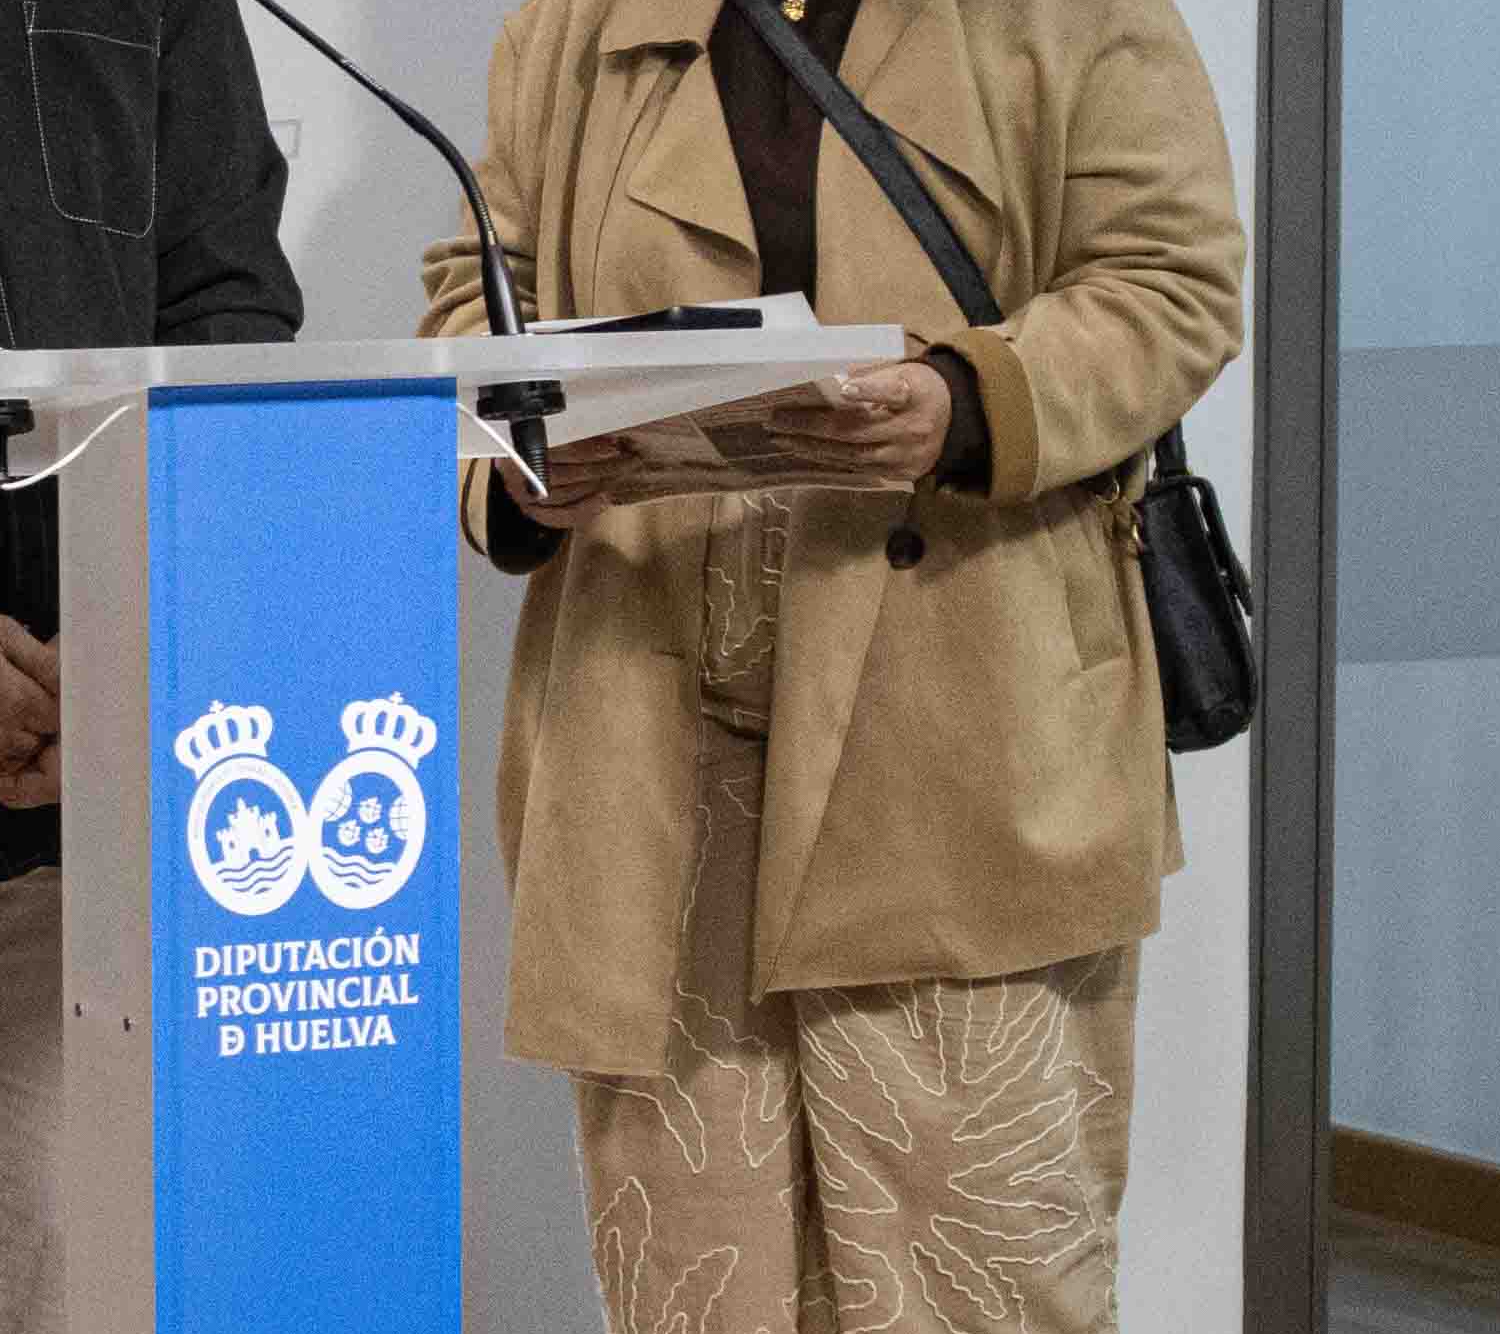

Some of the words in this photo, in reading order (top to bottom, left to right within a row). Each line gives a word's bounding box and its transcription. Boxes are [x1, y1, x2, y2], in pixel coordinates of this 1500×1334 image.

[194, 927, 420, 979] DIPUTACIÓN
[196, 973, 419, 1018] PROVINCIAL
[255, 1014, 396, 1055] HUELVA
